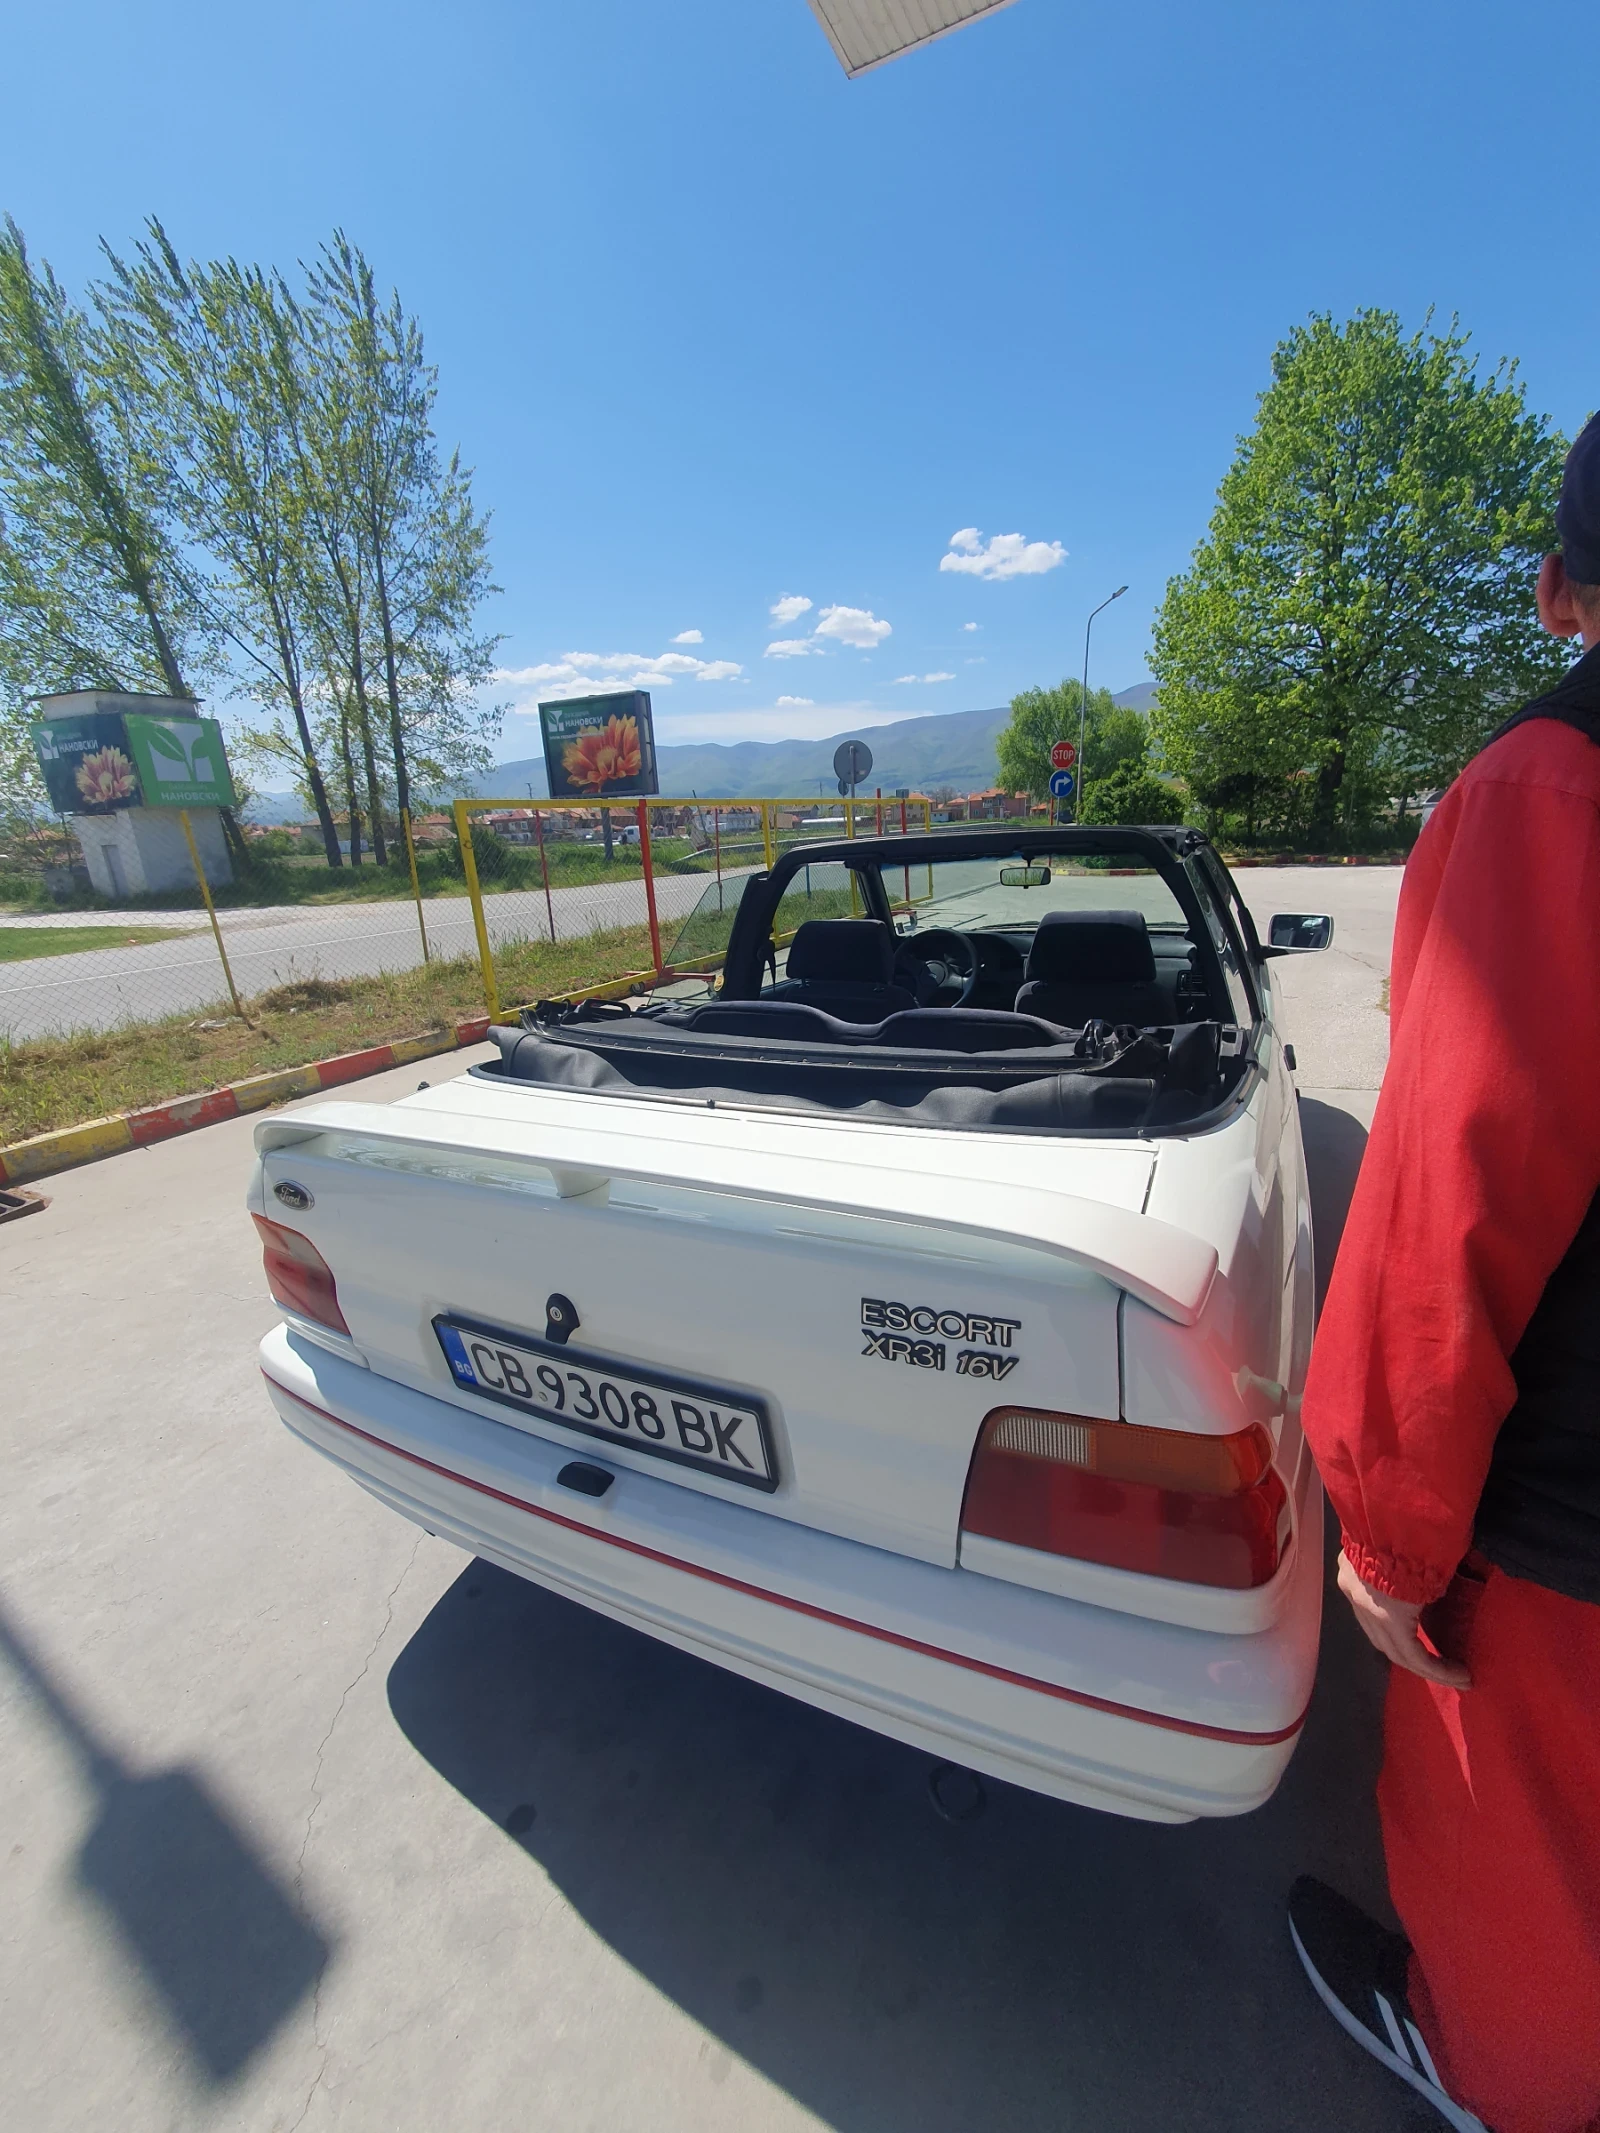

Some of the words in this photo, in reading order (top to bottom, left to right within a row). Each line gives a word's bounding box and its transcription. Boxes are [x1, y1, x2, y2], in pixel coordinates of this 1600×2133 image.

[565, 716, 603, 727] НАНОВСКИ
[59, 739, 98, 753] НАНОВСКИ
[1053, 750, 1074, 760] STOP
[160, 791, 220, 801] НАНОВСКИ
[279, 1186, 301, 1205] Ford
[861, 1297, 1021, 1347] ESCORT
[861, 1329, 945, 1371] XR3i
[956, 1350, 1019, 1380] 16V
[455, 1360, 473, 1376] BG
